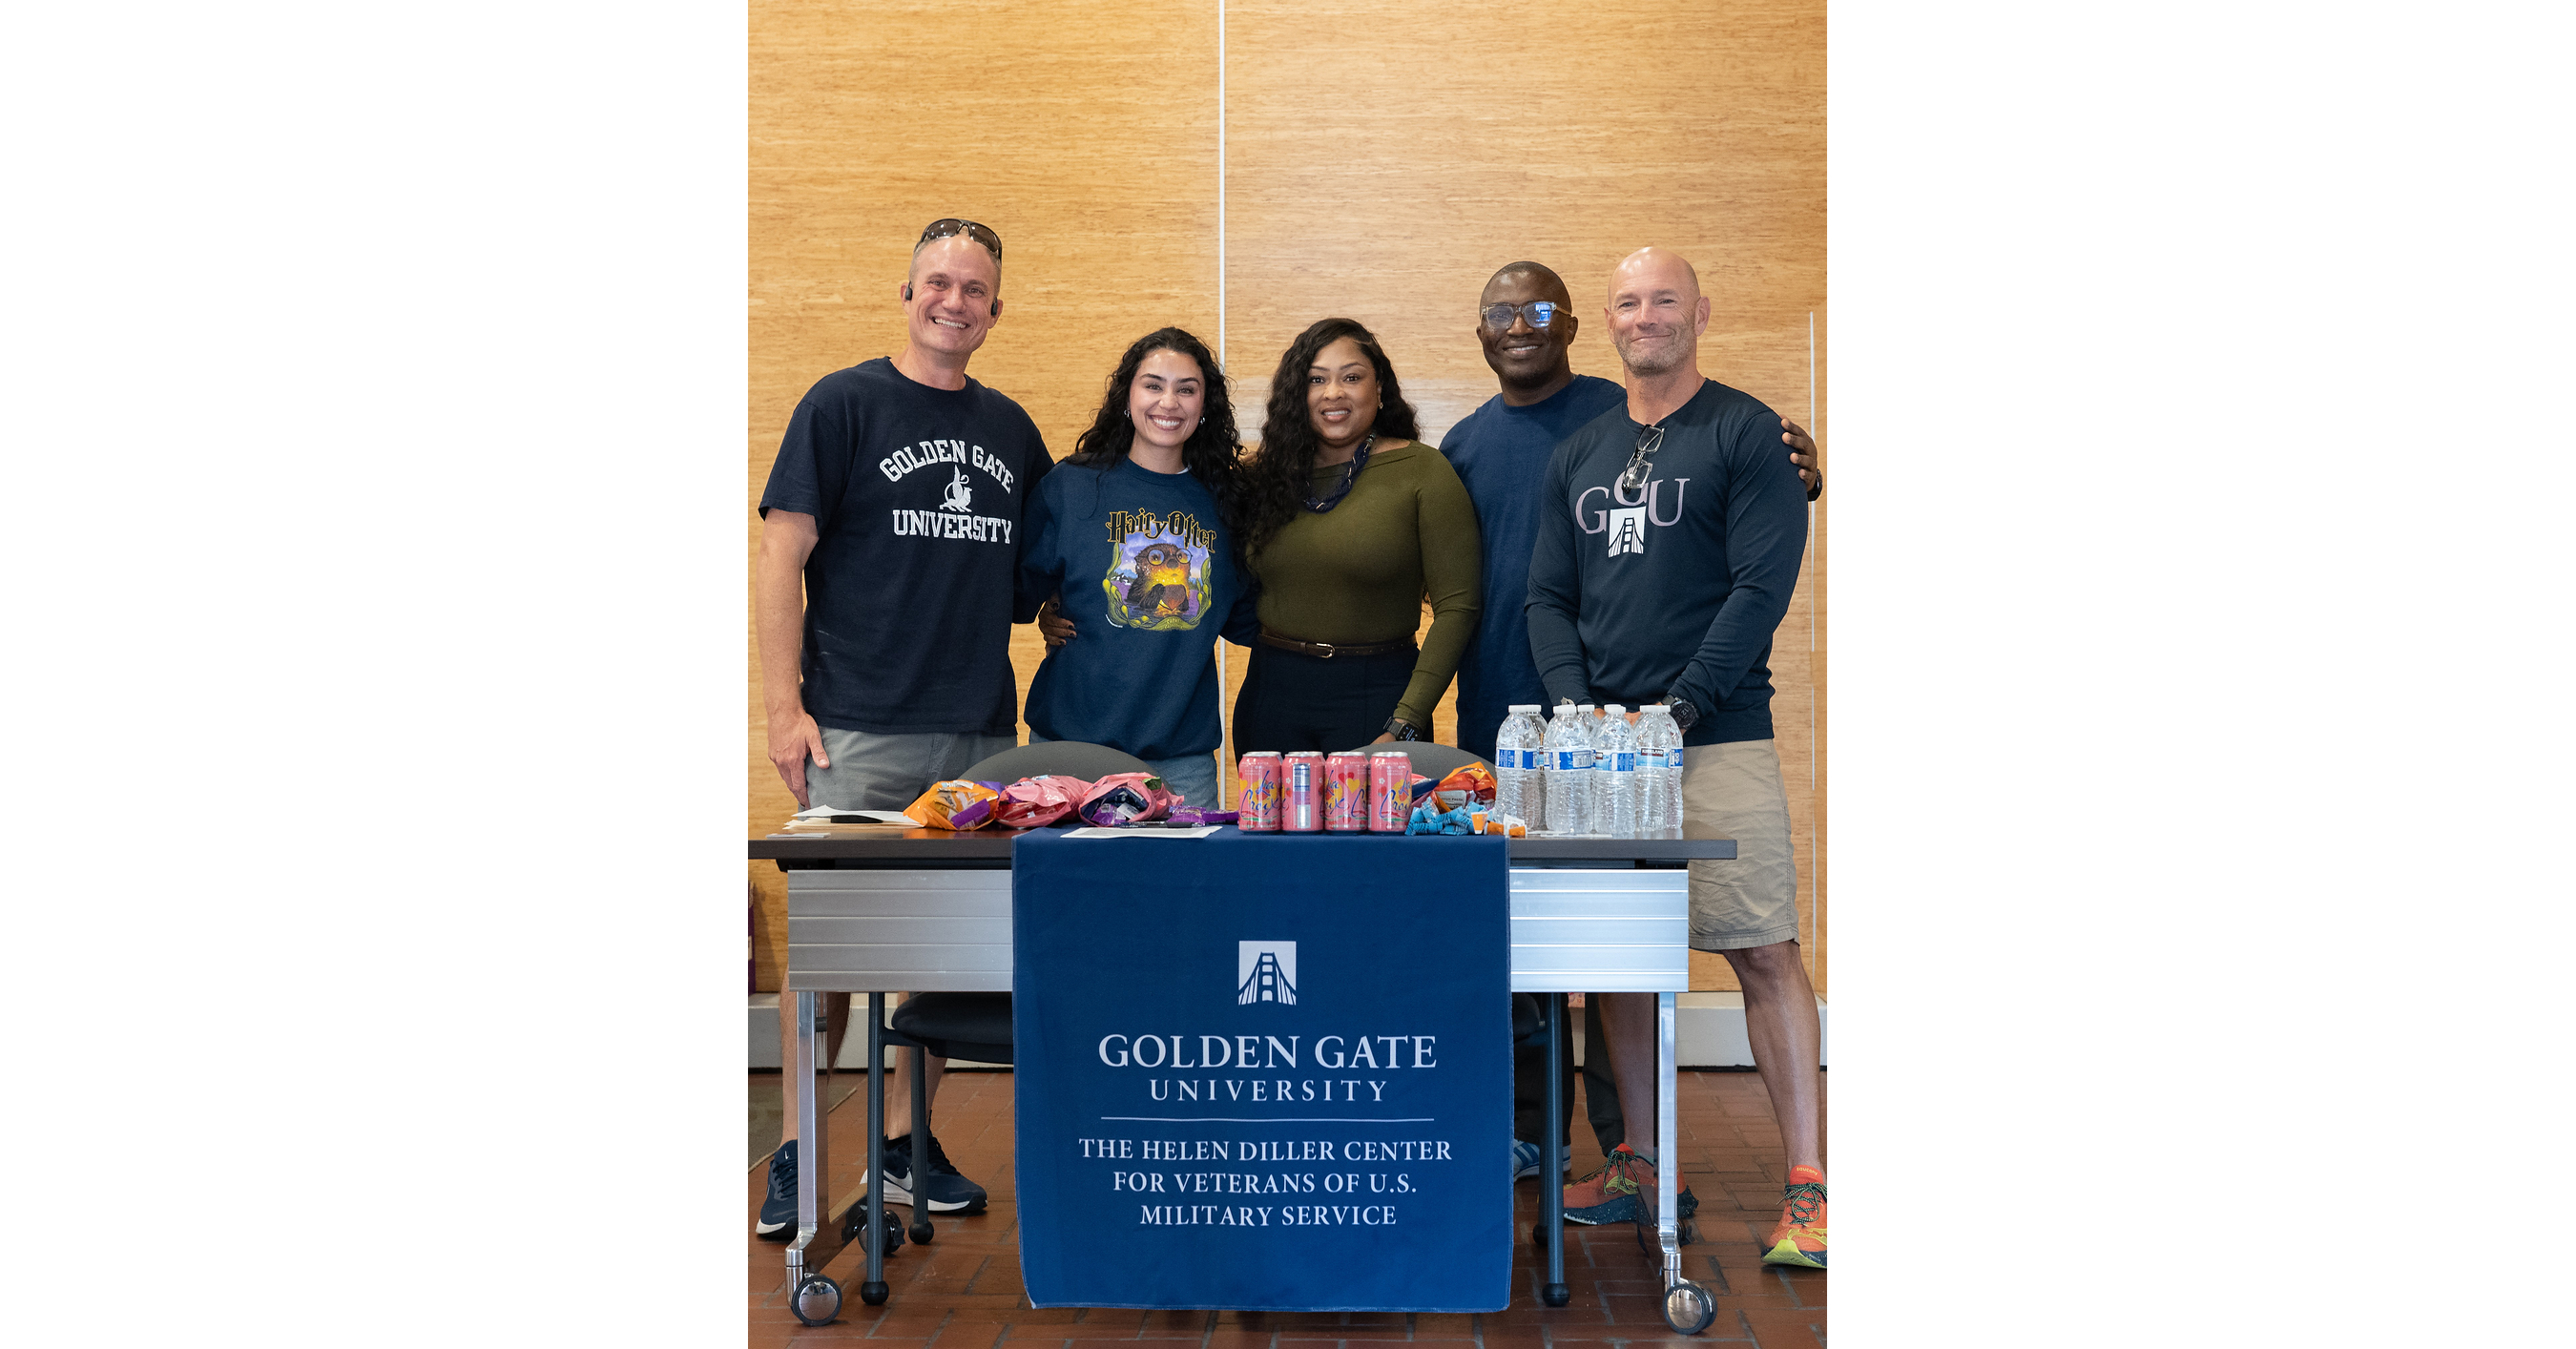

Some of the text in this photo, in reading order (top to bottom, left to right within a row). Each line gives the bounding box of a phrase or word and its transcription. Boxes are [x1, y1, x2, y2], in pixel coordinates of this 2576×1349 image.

[879, 439, 1014, 494] GOLDEN GATE
[892, 509, 1012, 544] UNIVERSITY
[1105, 507, 1217, 553] Hairy Otter
[1098, 1034, 1437, 1069] GOLDEN GATE
[1150, 1079, 1386, 1102] UNIVERSITY
[1078, 1138, 1452, 1161] THE HELEN DILLER CENTER
[1796, 1167, 1818, 1175] saucony
[1113, 1172, 1417, 1194] FOR VETERANS OF U.S.
[1140, 1205, 1397, 1227] MILITARY SERVICE
